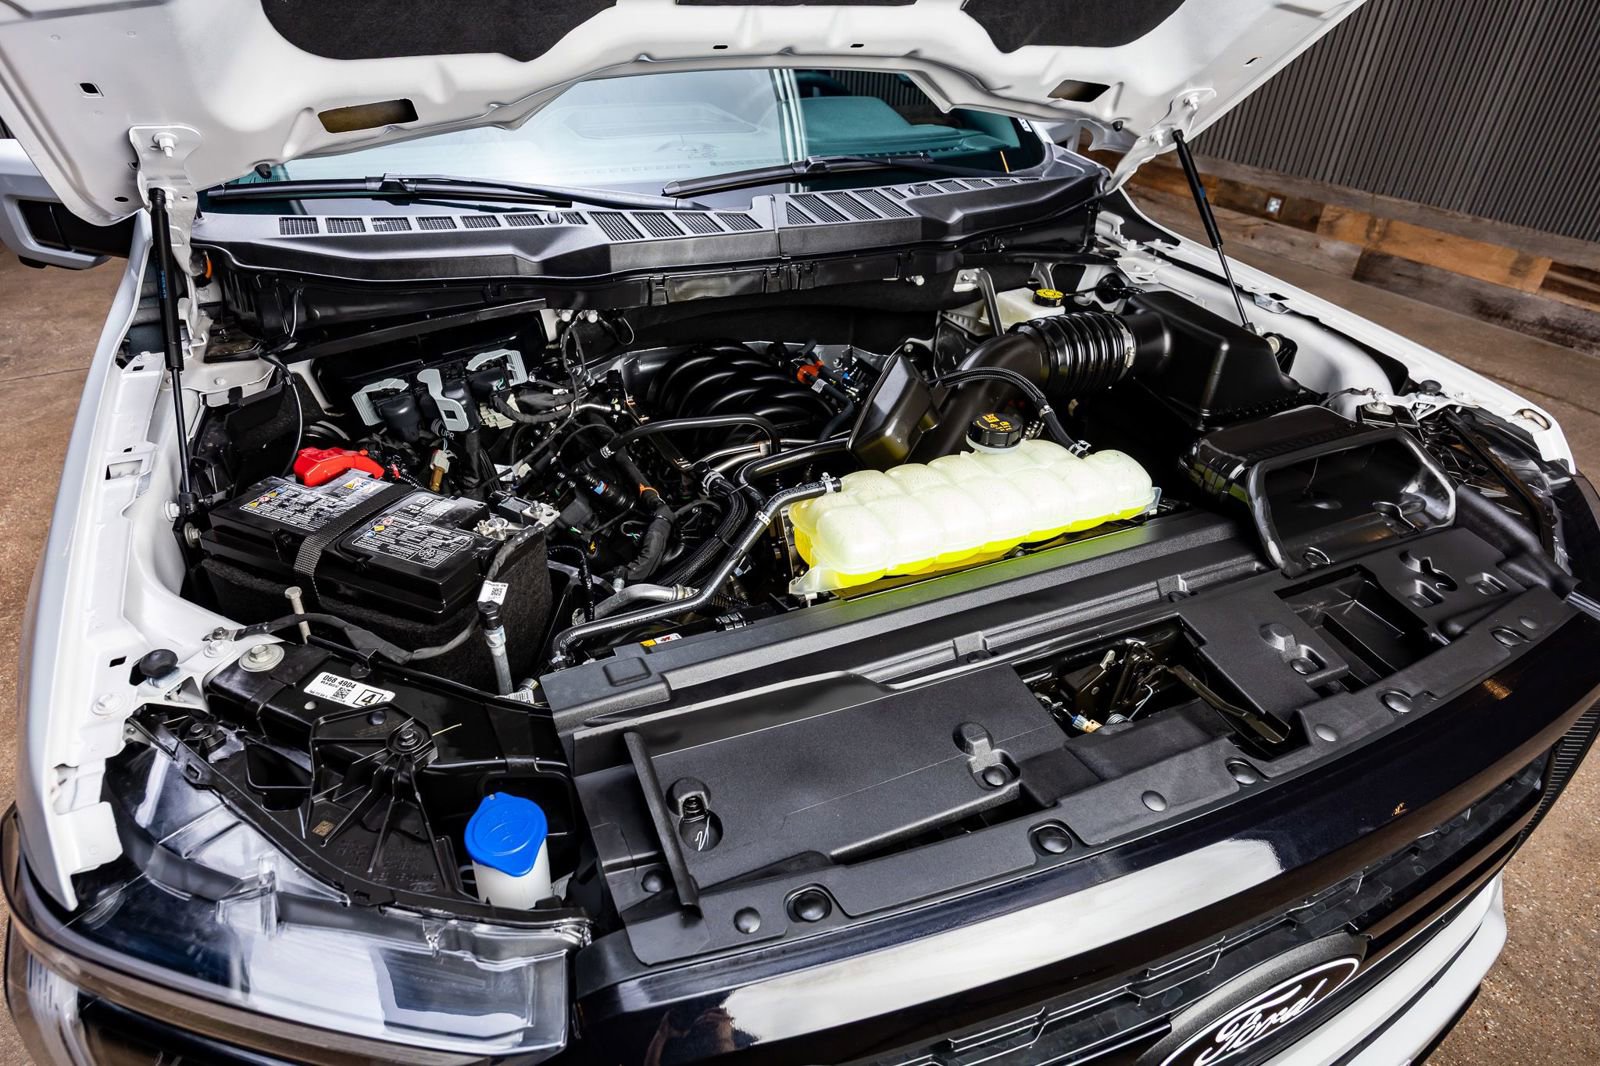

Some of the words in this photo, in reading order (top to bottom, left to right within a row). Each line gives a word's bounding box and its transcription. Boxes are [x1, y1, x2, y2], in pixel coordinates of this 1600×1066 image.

[322, 675, 338, 683] 068
[338, 680, 357, 689] 4904
[361, 693, 377, 706] 4
[1193, 977, 1328, 1066] Ford
